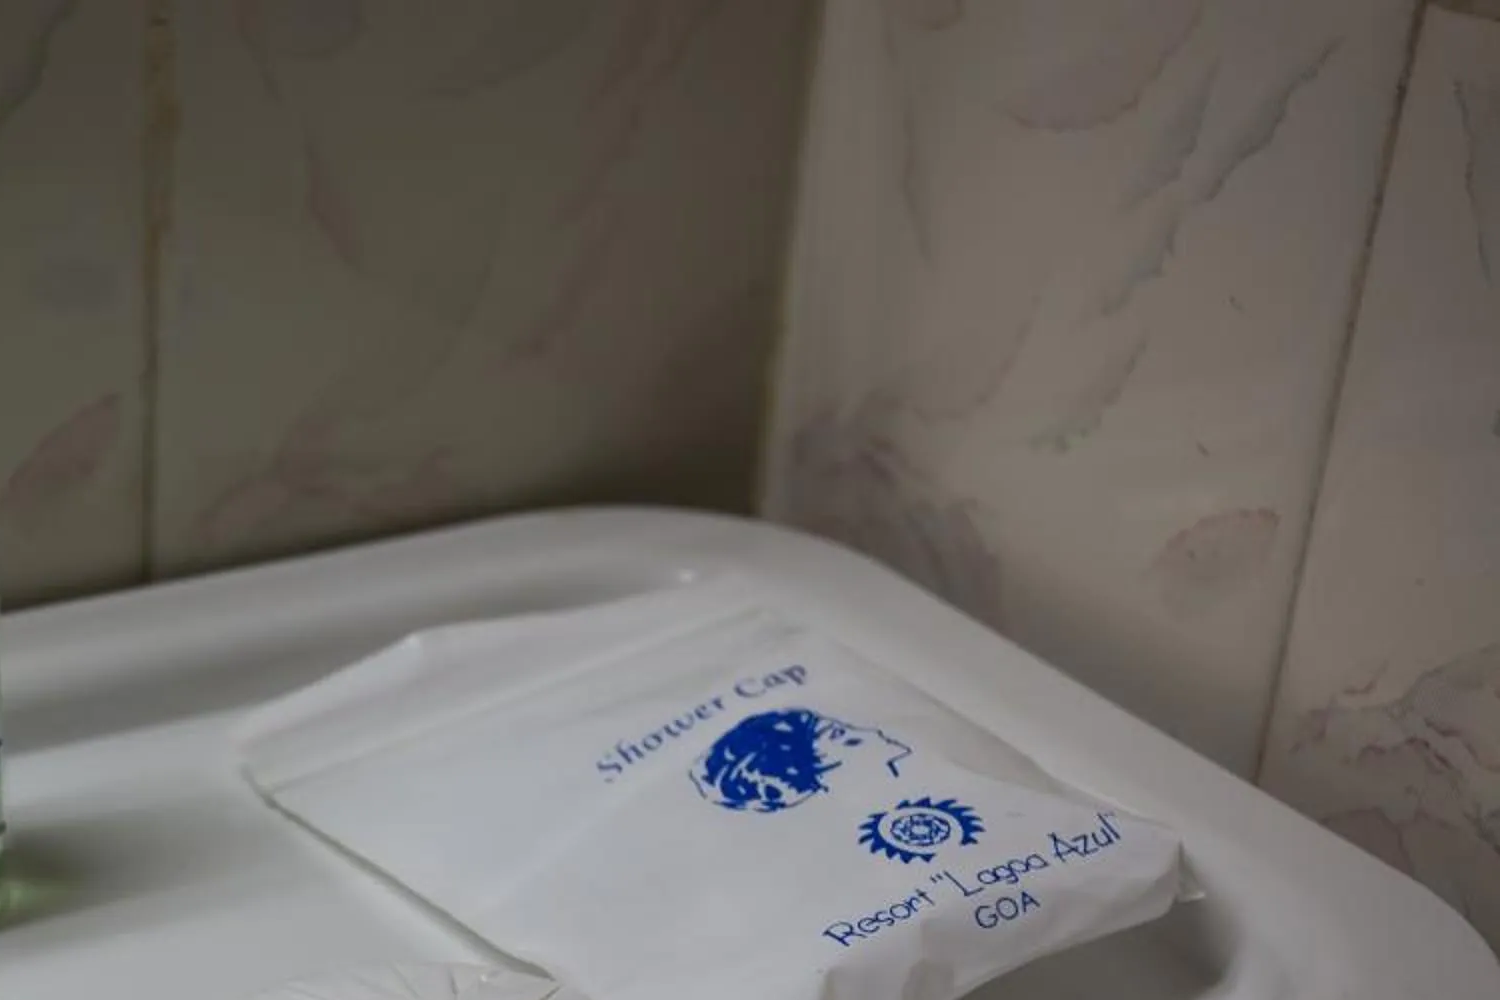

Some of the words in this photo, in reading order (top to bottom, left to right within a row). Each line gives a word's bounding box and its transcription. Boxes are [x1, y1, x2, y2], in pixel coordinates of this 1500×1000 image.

[596, 697, 726, 783] Shower
[733, 664, 808, 699] Cap
[821, 887, 936, 948] Resort
[929, 852, 1050, 897] "Lagoa
[974, 890, 1041, 930] GOA
